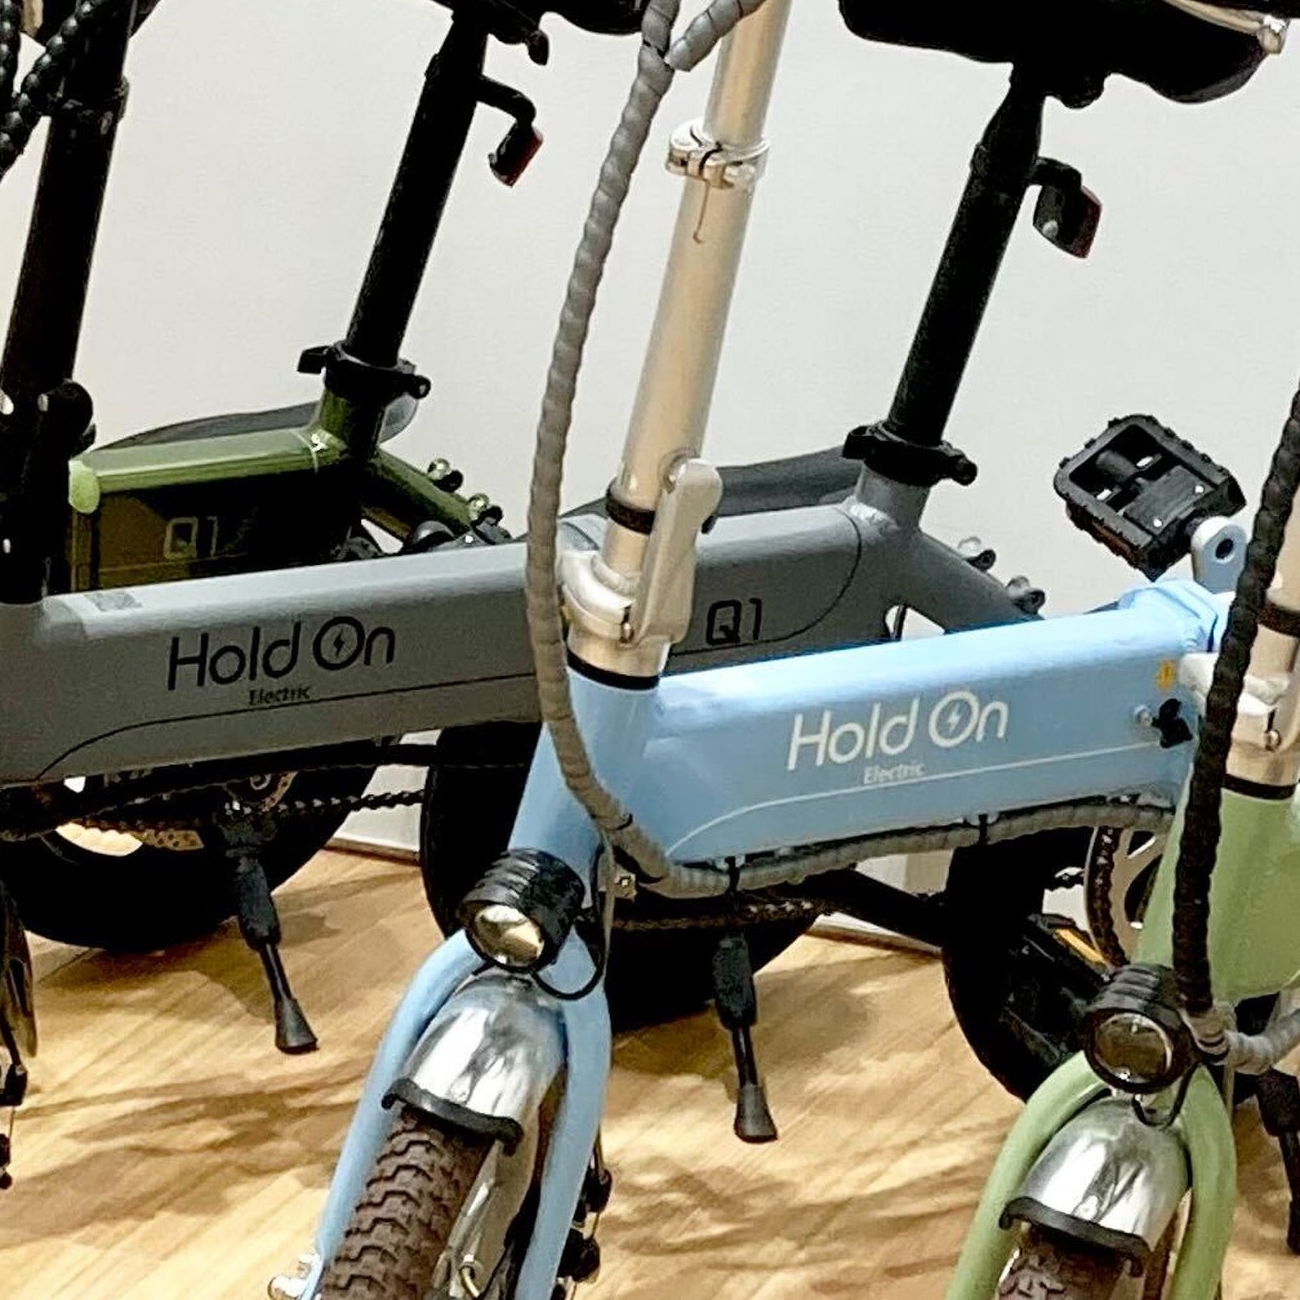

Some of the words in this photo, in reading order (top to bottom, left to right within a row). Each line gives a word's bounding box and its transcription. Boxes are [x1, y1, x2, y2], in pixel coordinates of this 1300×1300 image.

[163, 515, 219, 561] Q1
[705, 597, 762, 646] Q1
[167, 619, 303, 691] Hold
[312, 615, 396, 671] On
[787, 697, 921, 772] Hold
[928, 690, 1009, 748] On
[862, 760, 929, 785] Electric
